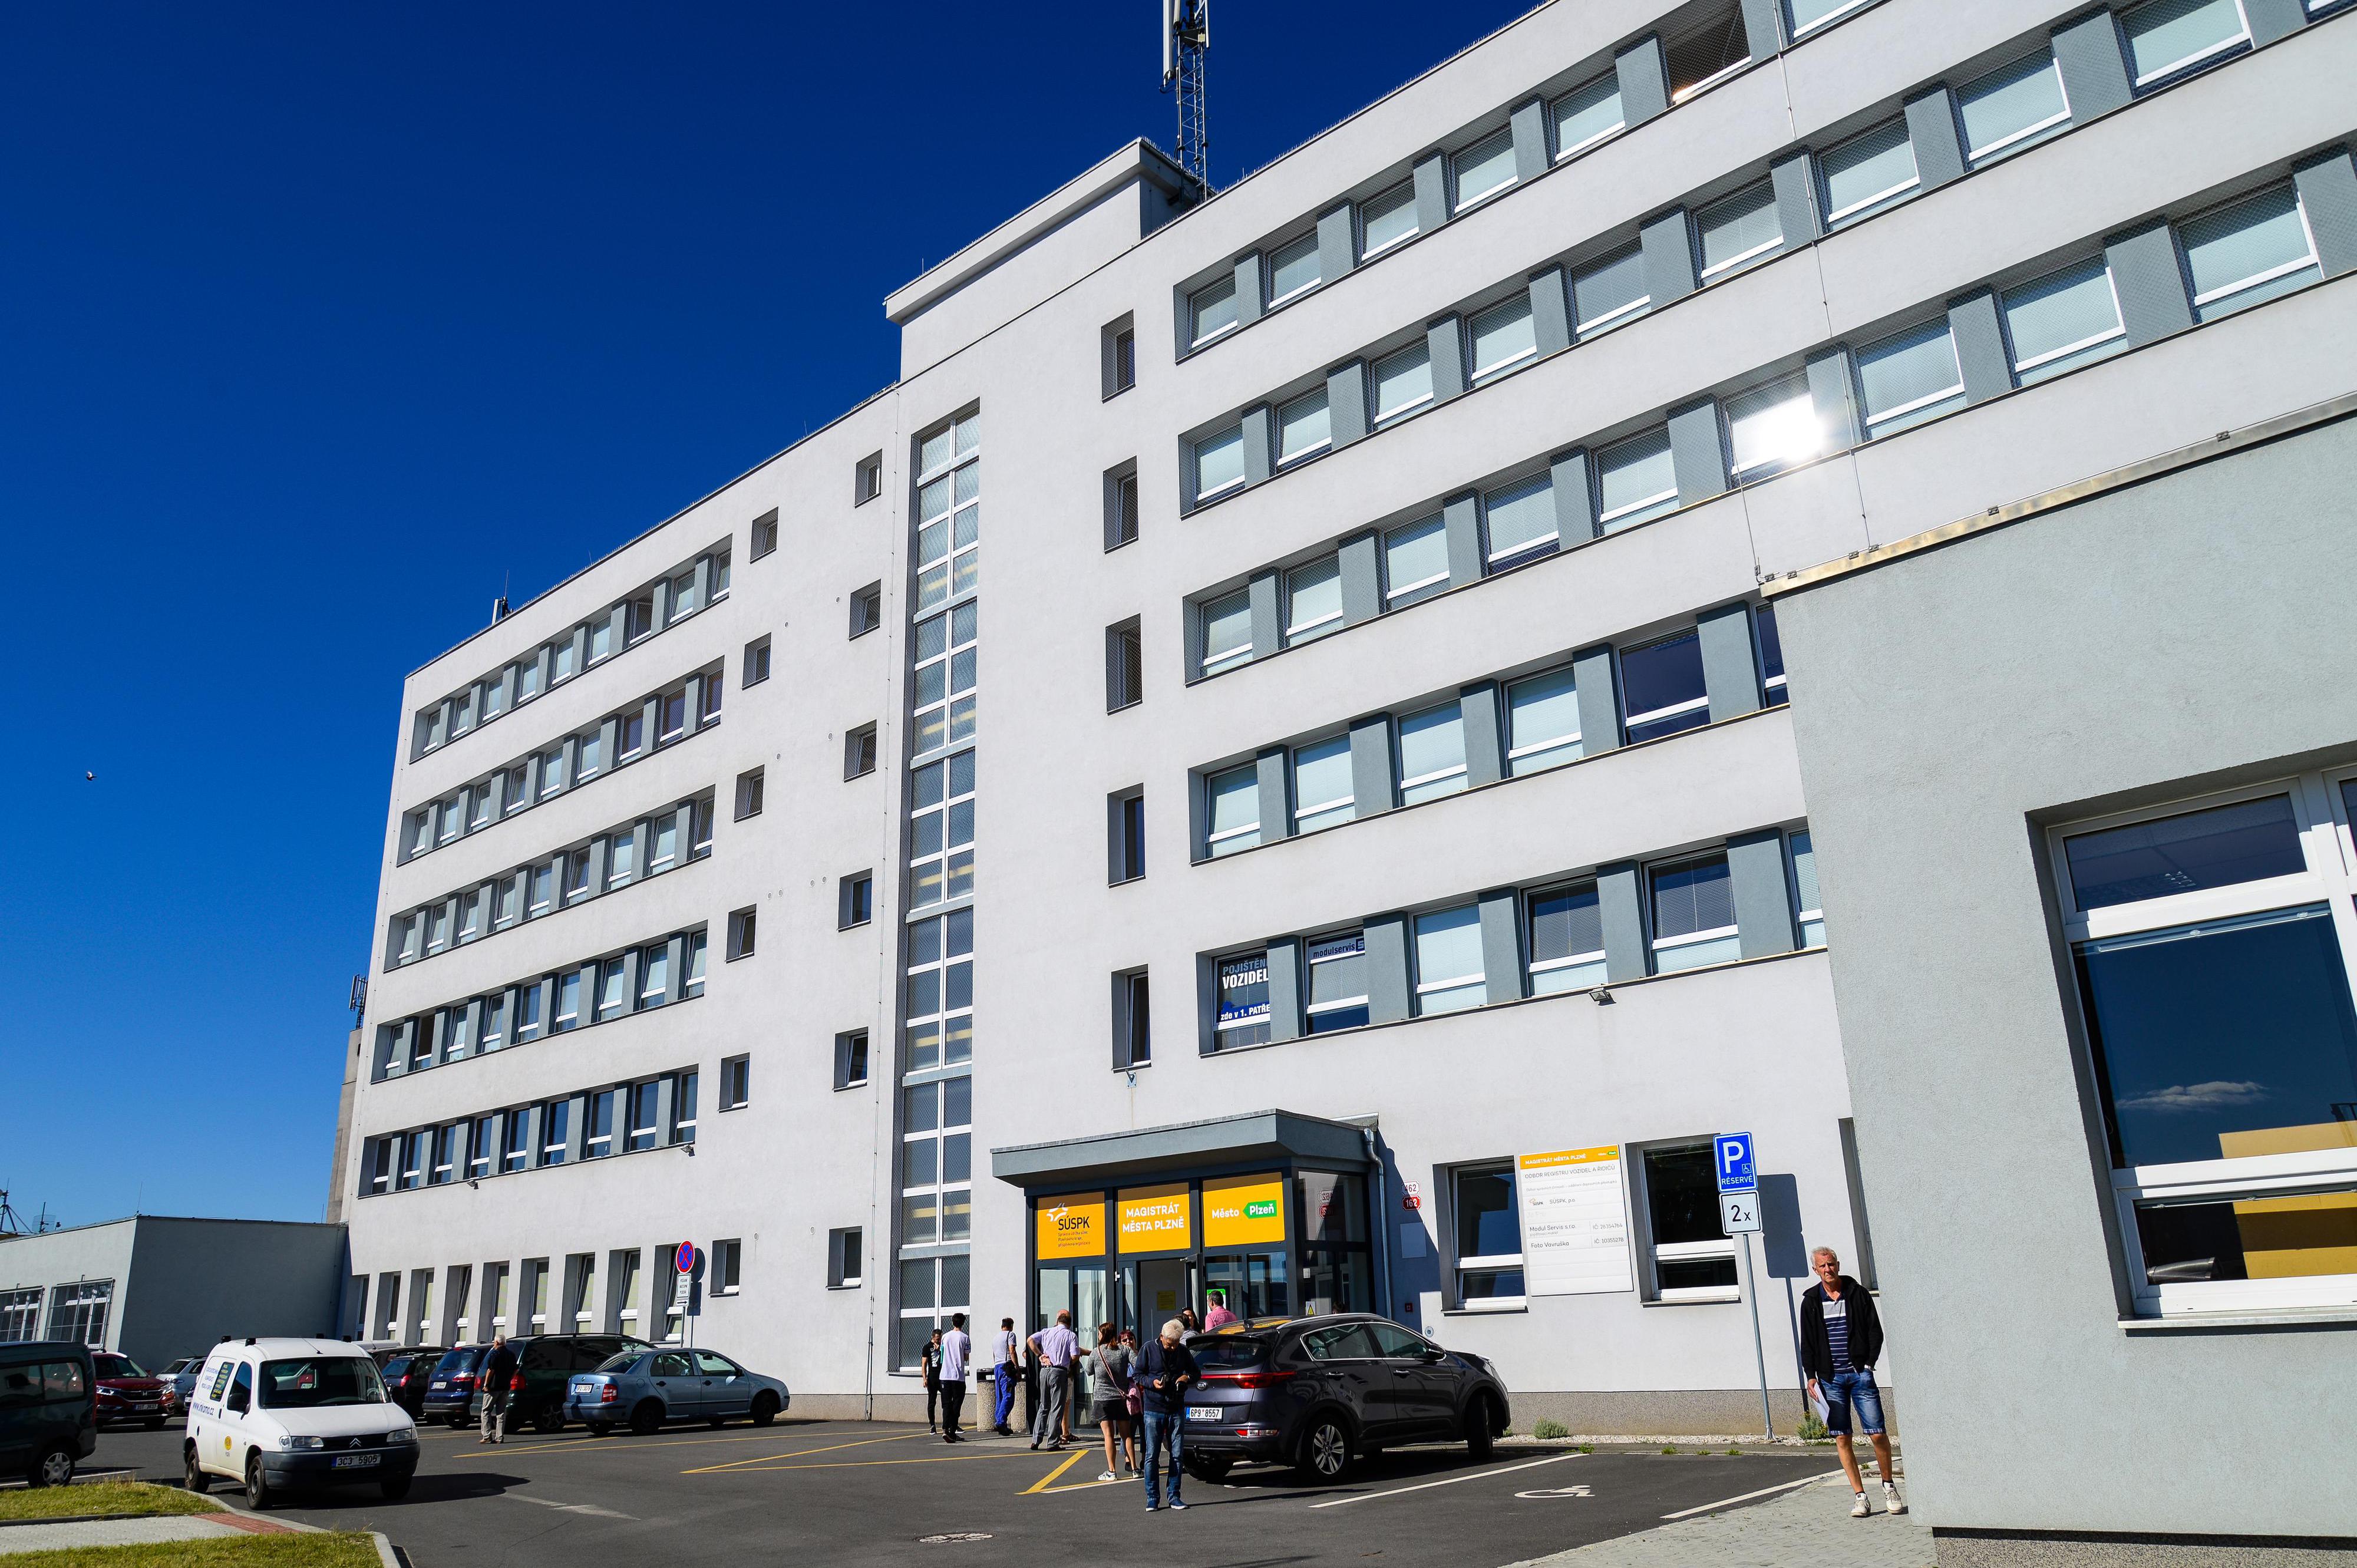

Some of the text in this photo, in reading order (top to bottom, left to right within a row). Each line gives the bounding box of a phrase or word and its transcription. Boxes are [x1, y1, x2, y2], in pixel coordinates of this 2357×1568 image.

[1313, 943, 1355, 958] modulservis
[1222, 968, 1269, 989] VOZIDEL
[1220, 1012, 1233, 1021] zde
[1240, 1009, 1247, 1017] 1.
[1249, 1003, 1270, 1015] PATŘE
[1525, 1157, 1553, 1165] MAGISTRÁT
[1722, 1141, 1744, 1173] P
[1721, 1176, 1753, 1185] RÉSERVÉ
[1126, 1202, 1180, 1219] MAGISTRÁT
[1406, 1199, 1417, 1207] 162
[1212, 1203, 1274, 1219] Město Plzeň
[1058, 1215, 1090, 1230] SÚSPK
[1123, 1216, 1184, 1233] MĚSTA PLZNĚ
[1191, 1409, 1220, 1418] 6P9 8557
[338, 1455, 378, 1465] 3C3 5905
